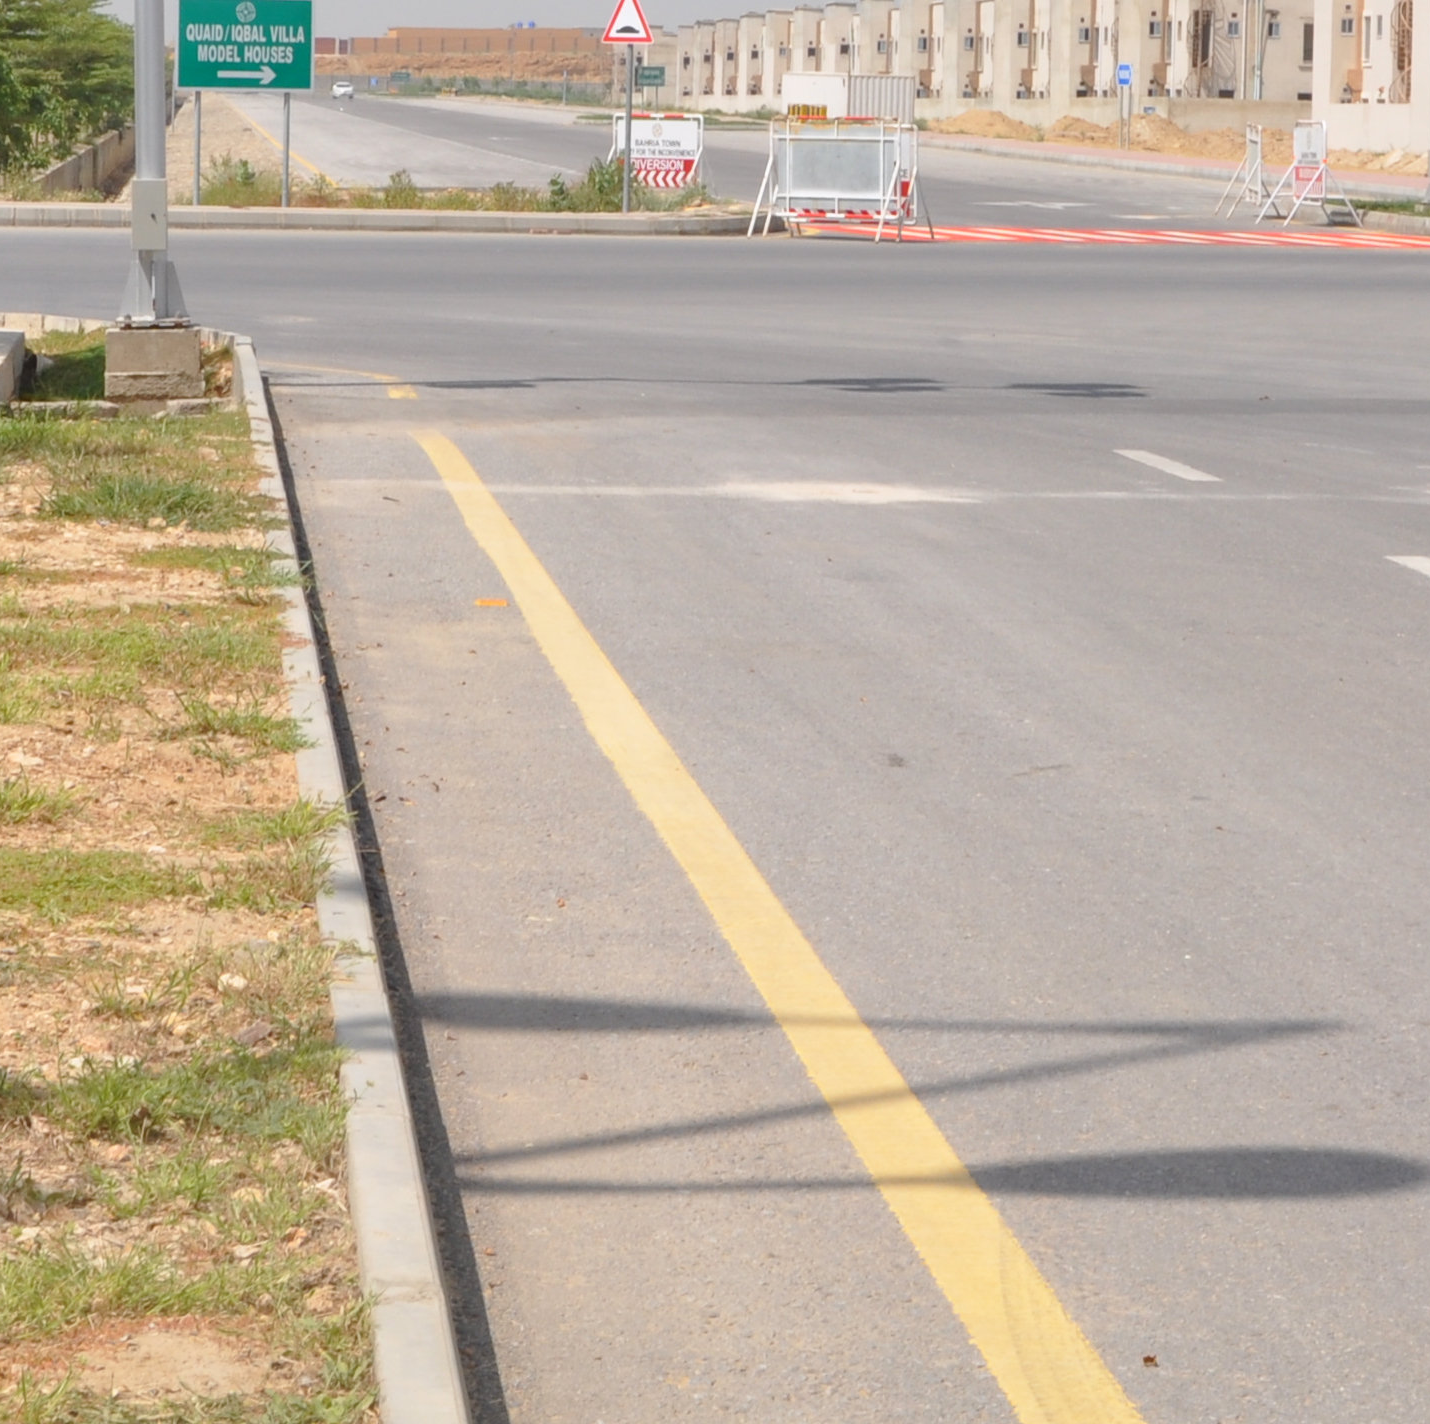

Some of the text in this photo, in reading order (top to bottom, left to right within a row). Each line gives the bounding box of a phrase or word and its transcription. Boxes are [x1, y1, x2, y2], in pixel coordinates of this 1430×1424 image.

[270, 25, 306, 43] VILLA
[197, 44, 294, 64] MODEL HOUSES
[634, 139, 681, 148] BAHRIA TOWN
[636, 148, 646, 156] FOR
